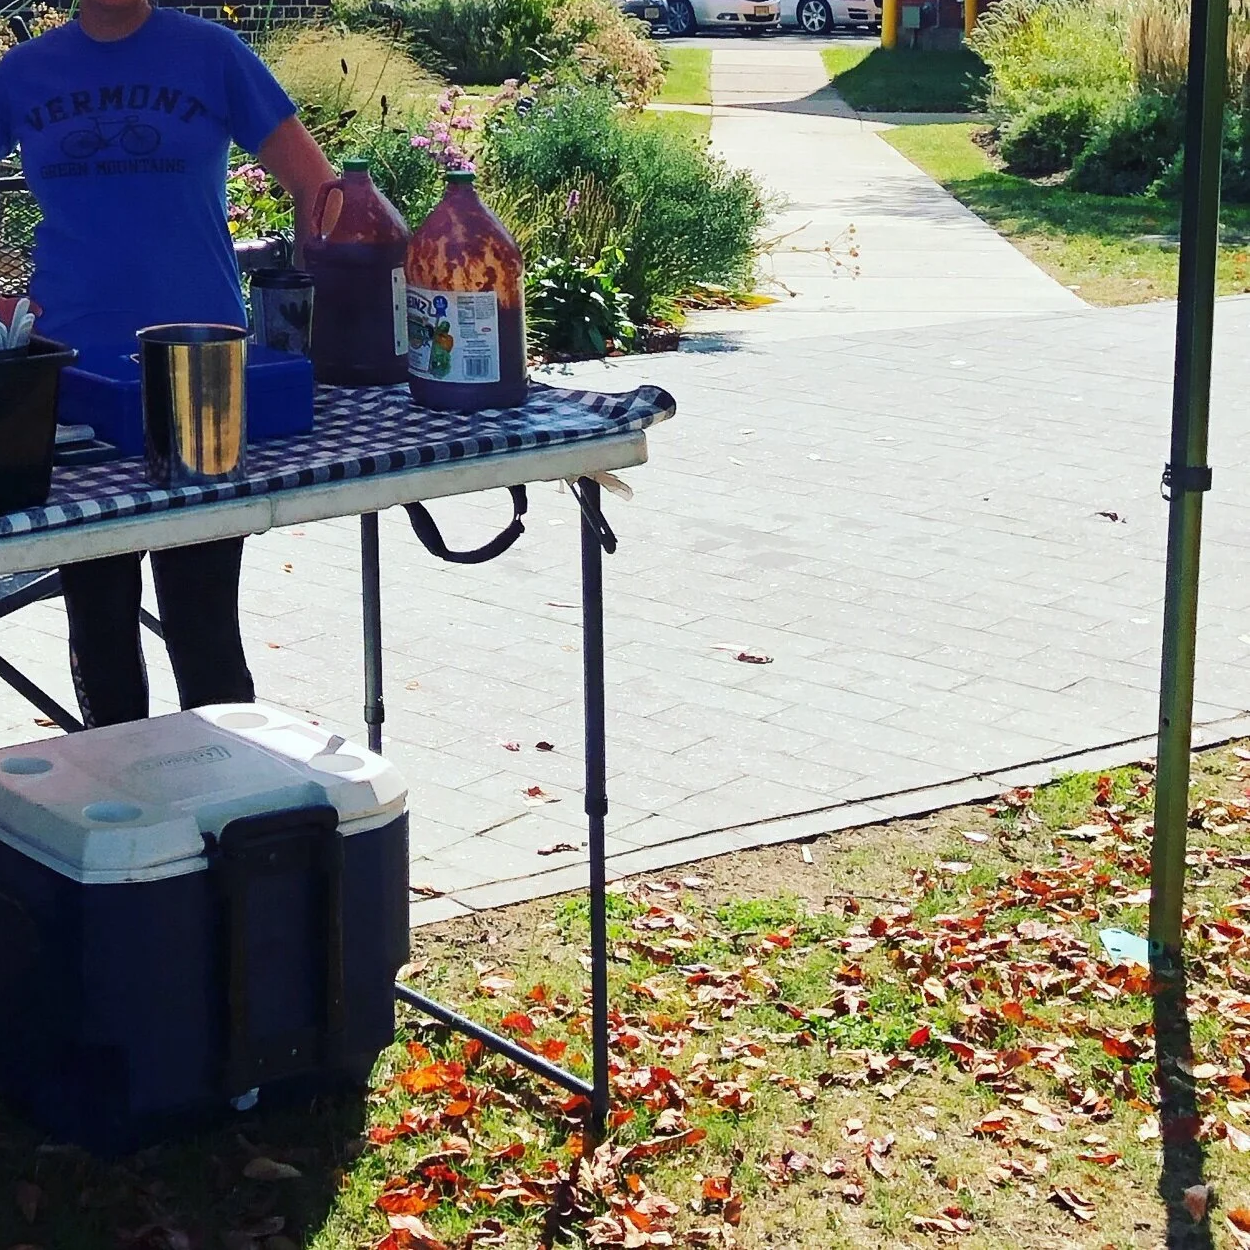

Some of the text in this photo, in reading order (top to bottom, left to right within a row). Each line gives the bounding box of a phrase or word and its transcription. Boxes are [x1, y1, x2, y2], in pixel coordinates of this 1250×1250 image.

[25, 84, 208, 132] VERMONT
[41, 158, 186, 180] GREEN MOUNTAINS
